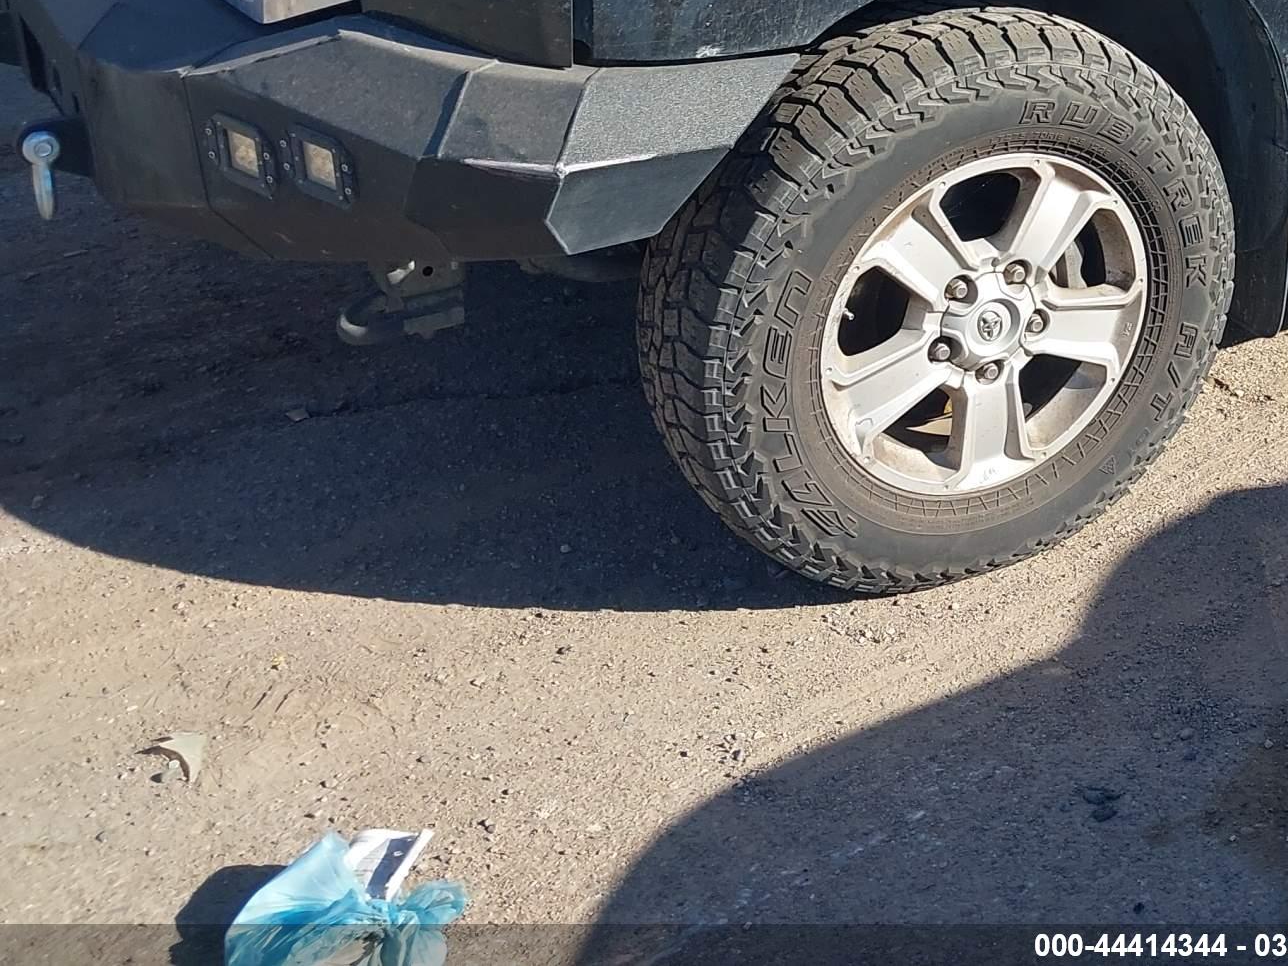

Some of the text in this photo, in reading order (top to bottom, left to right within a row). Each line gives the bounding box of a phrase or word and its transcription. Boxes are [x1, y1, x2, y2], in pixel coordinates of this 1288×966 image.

[759, 267, 858, 539] FALKEN
[1019, 99, 1207, 289] RUBITREK
[1150, 321, 1199, 422] A/T
